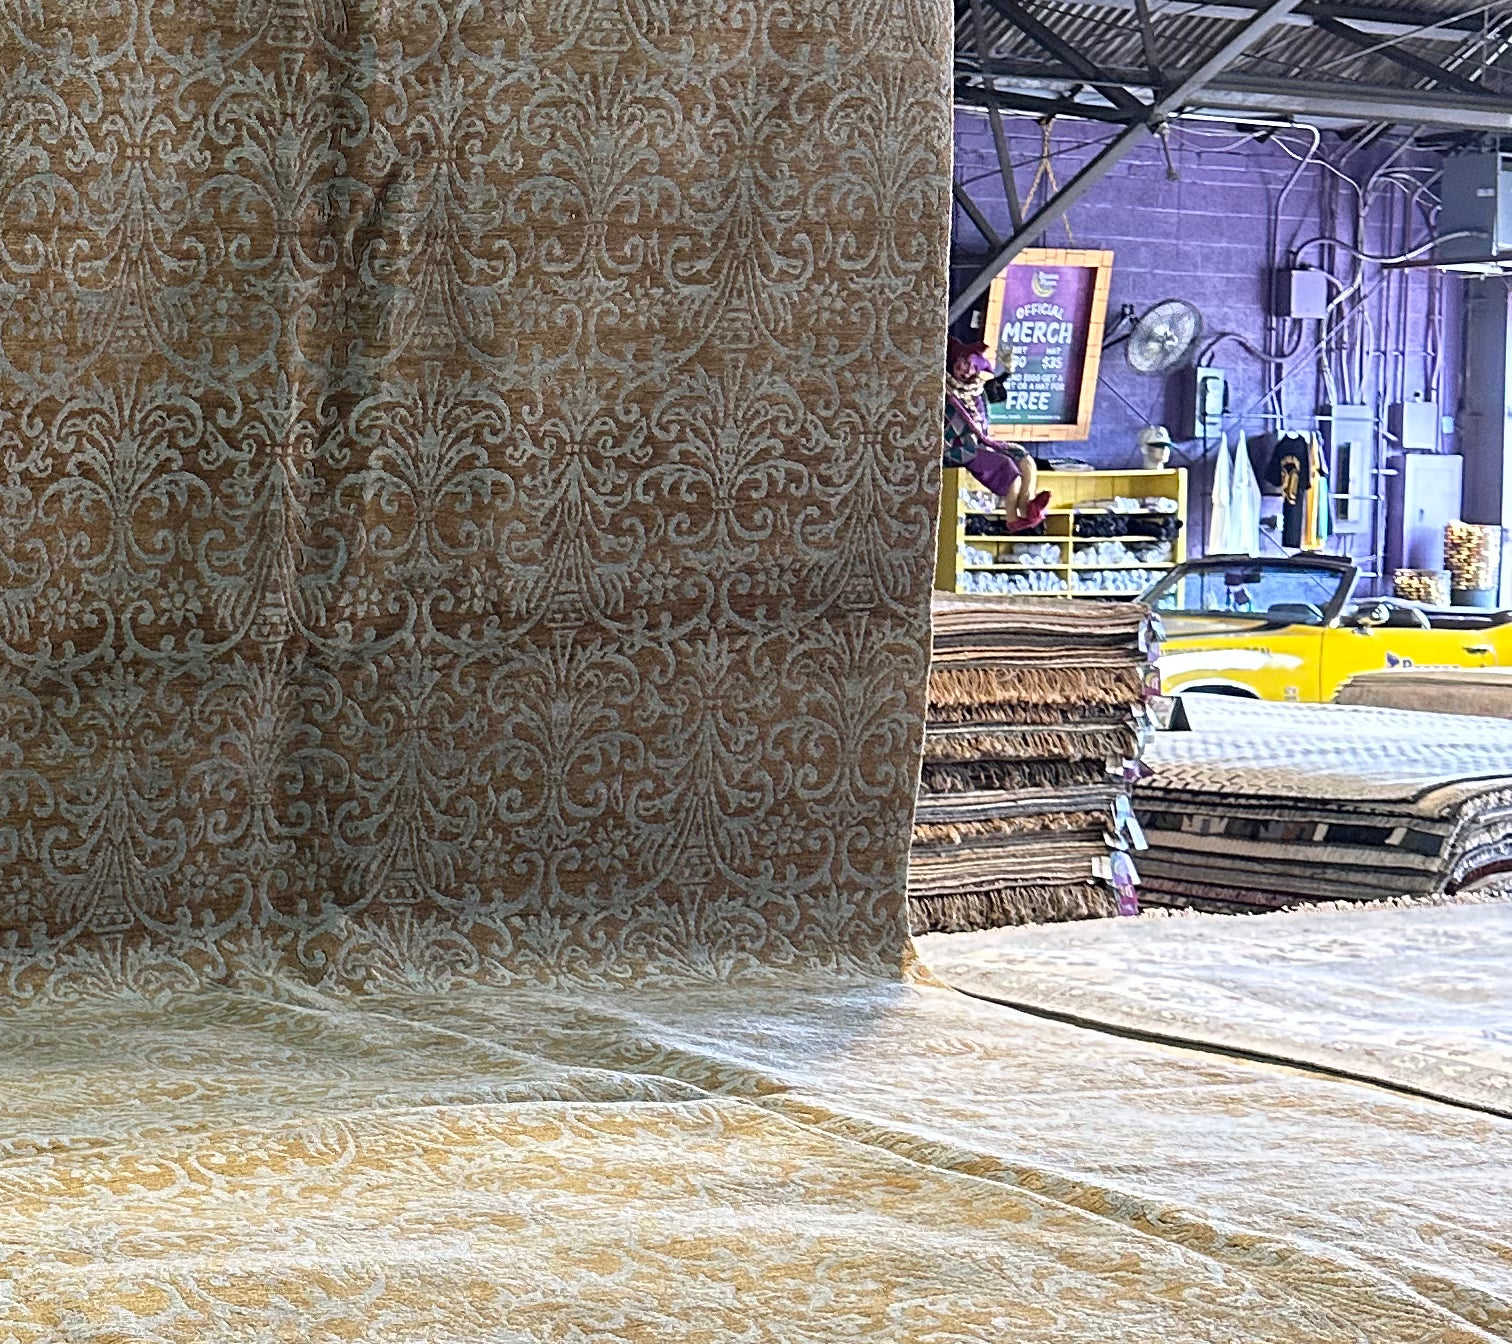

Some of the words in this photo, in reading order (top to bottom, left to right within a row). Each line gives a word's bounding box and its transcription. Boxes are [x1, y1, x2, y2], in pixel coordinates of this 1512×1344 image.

[1016, 302, 1065, 320] OFFICIAL
[1002, 321, 1073, 344] MERCH
[1005, 391, 1051, 410] FREE
